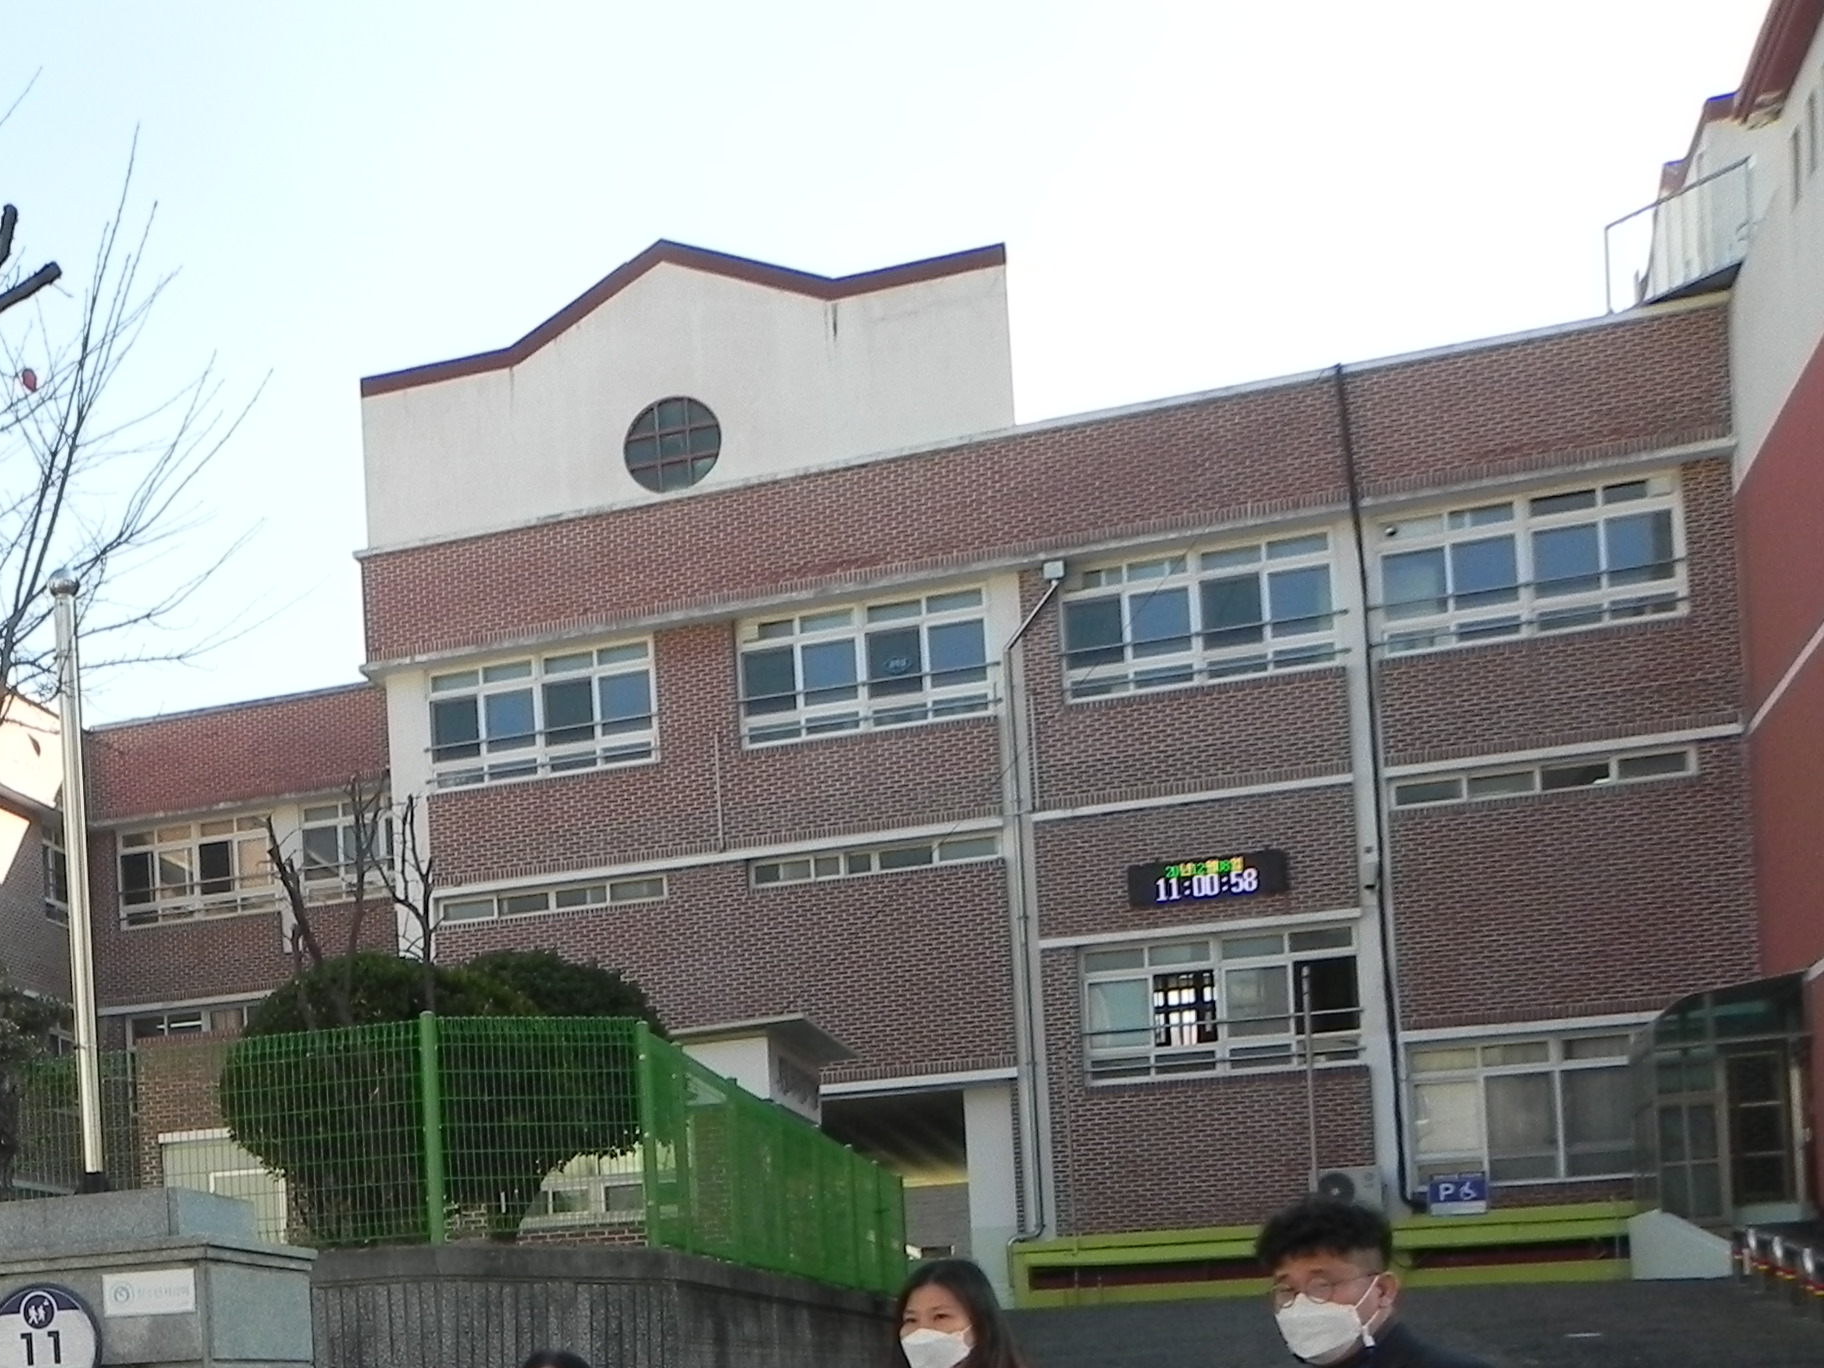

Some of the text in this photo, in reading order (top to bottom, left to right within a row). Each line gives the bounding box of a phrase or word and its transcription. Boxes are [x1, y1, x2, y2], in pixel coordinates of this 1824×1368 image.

[1156, 868, 1258, 901] 11:00:58
[1438, 1184, 1453, 1199] P
[20, 1330, 61, 1366] 11
